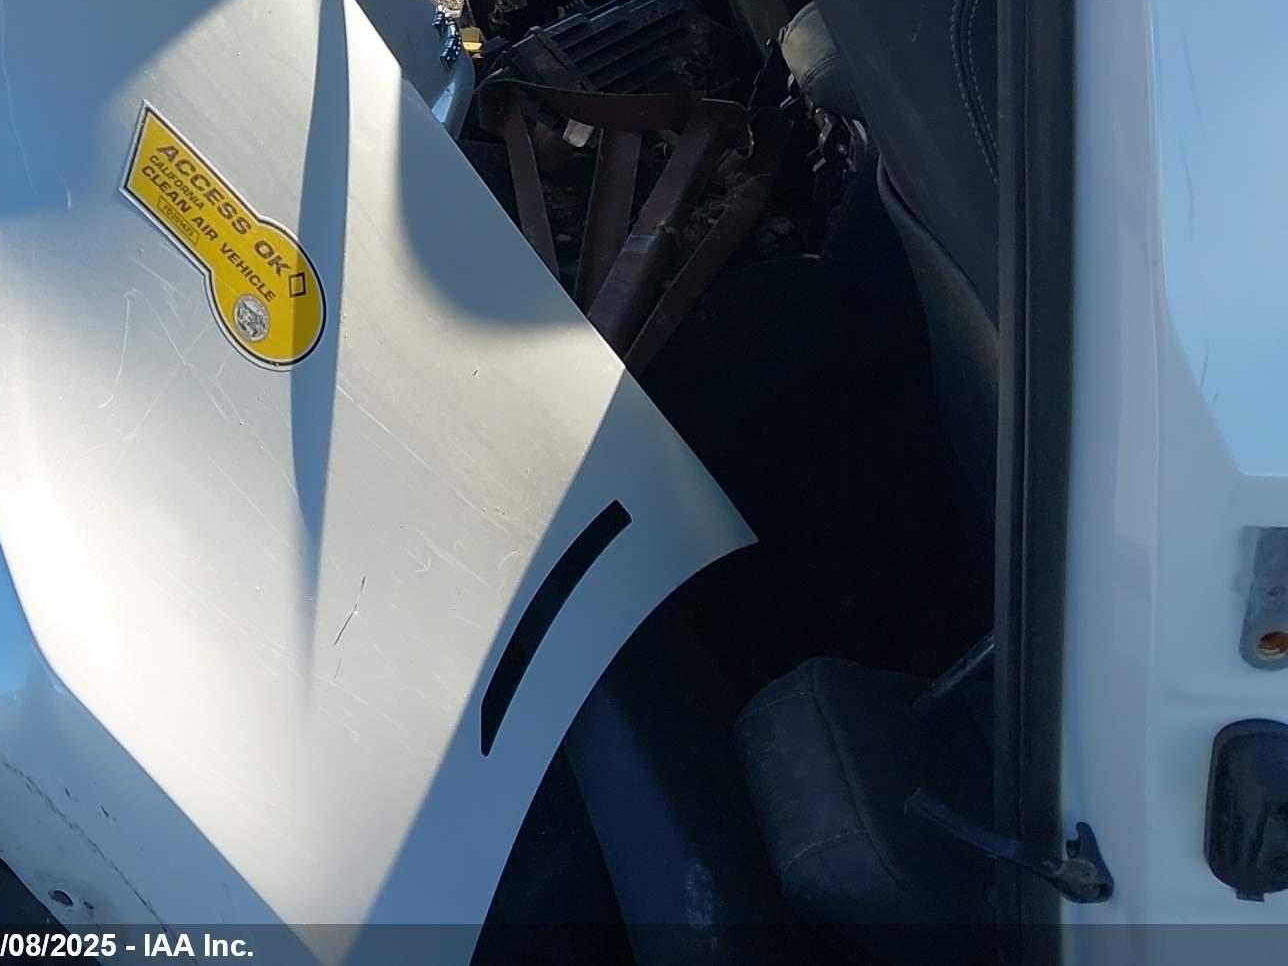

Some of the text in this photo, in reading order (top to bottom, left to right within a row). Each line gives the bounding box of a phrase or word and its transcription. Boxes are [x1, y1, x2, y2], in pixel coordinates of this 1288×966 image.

[142, 166, 191, 212] CLEAN
[192, 216, 218, 241] AIR
[220, 242, 276, 303] VEHICLE
[149, 155, 204, 210] CALIFORNIA
[156, 146, 291, 277] ACCESS OK
